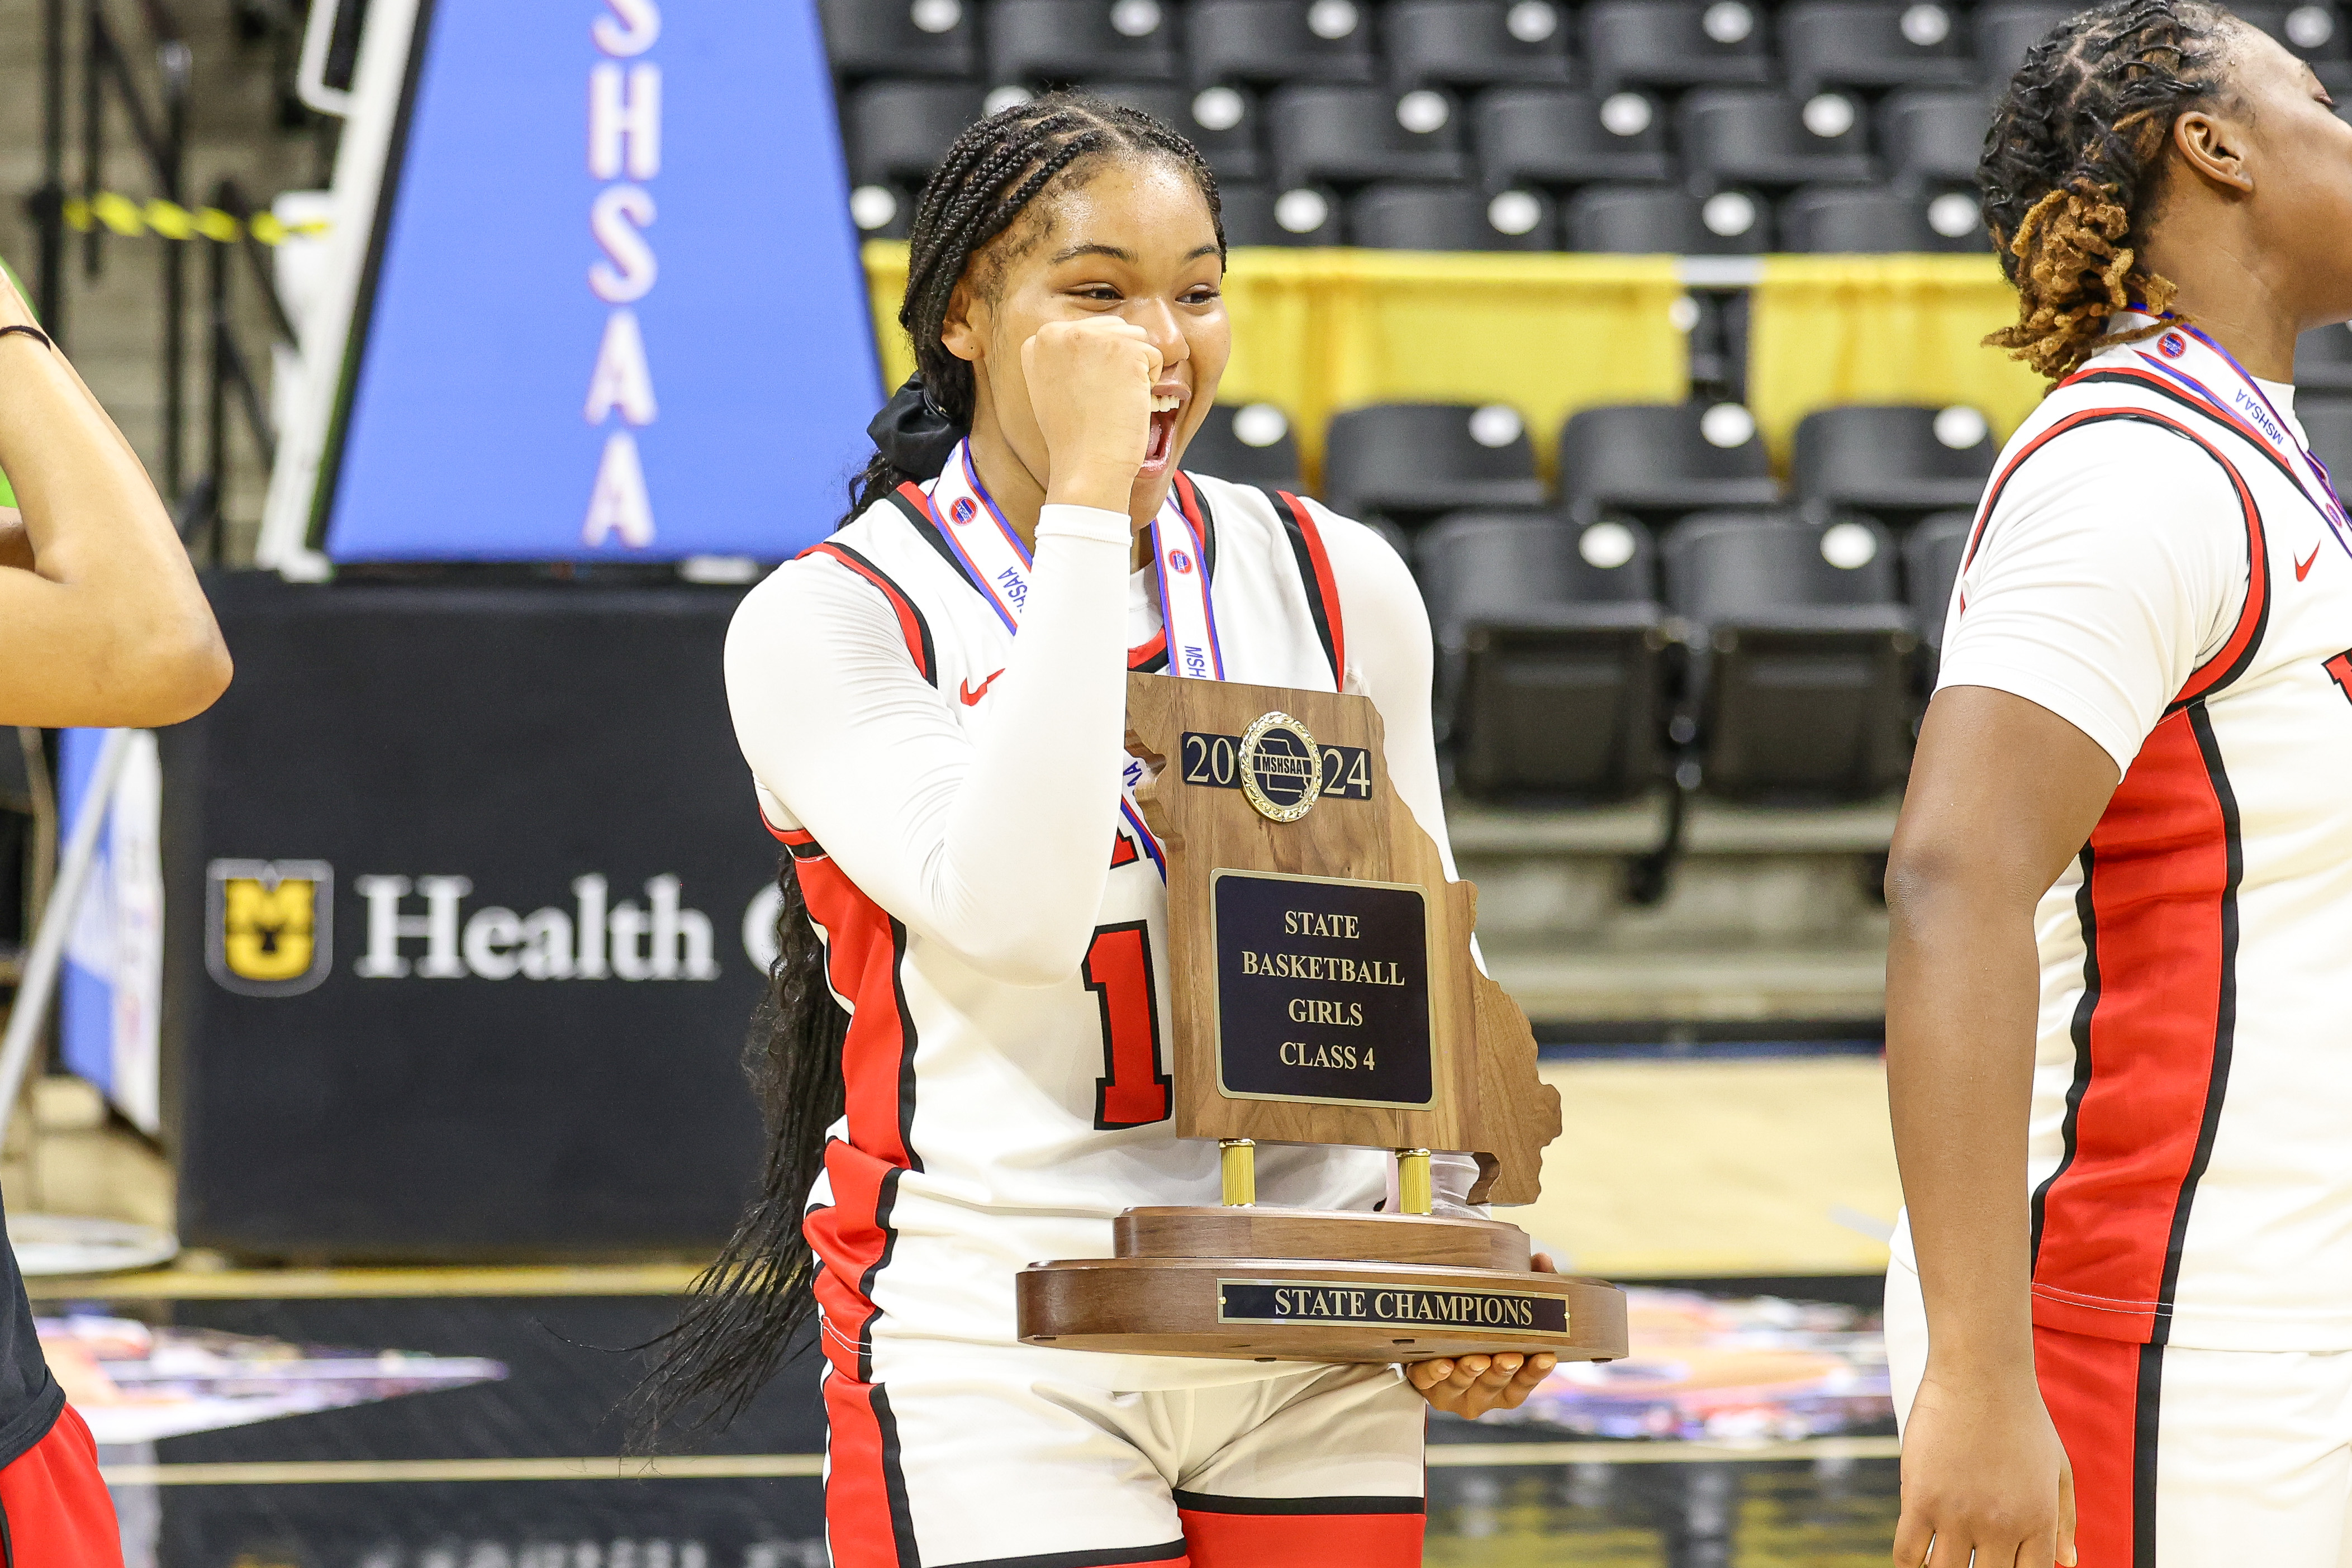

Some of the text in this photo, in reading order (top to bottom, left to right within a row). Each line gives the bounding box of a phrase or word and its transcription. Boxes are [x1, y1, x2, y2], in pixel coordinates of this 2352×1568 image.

[2235, 388, 2284, 445] MSHSAA
[997, 566, 1028, 614] HSAA
[1186, 735, 1371, 797] 20 24
[1262, 756, 1303, 775] MSHSAA
[354, 873, 721, 981] Health
[1285, 910, 1360, 939] STATE
[1242, 951, 1405, 986] BASKETBALL
[1288, 998, 1363, 1027] GIRLS
[1280, 1042, 1375, 1071] CLASS 4
[1275, 1288, 1533, 1325] STATE CHAMPIONS
